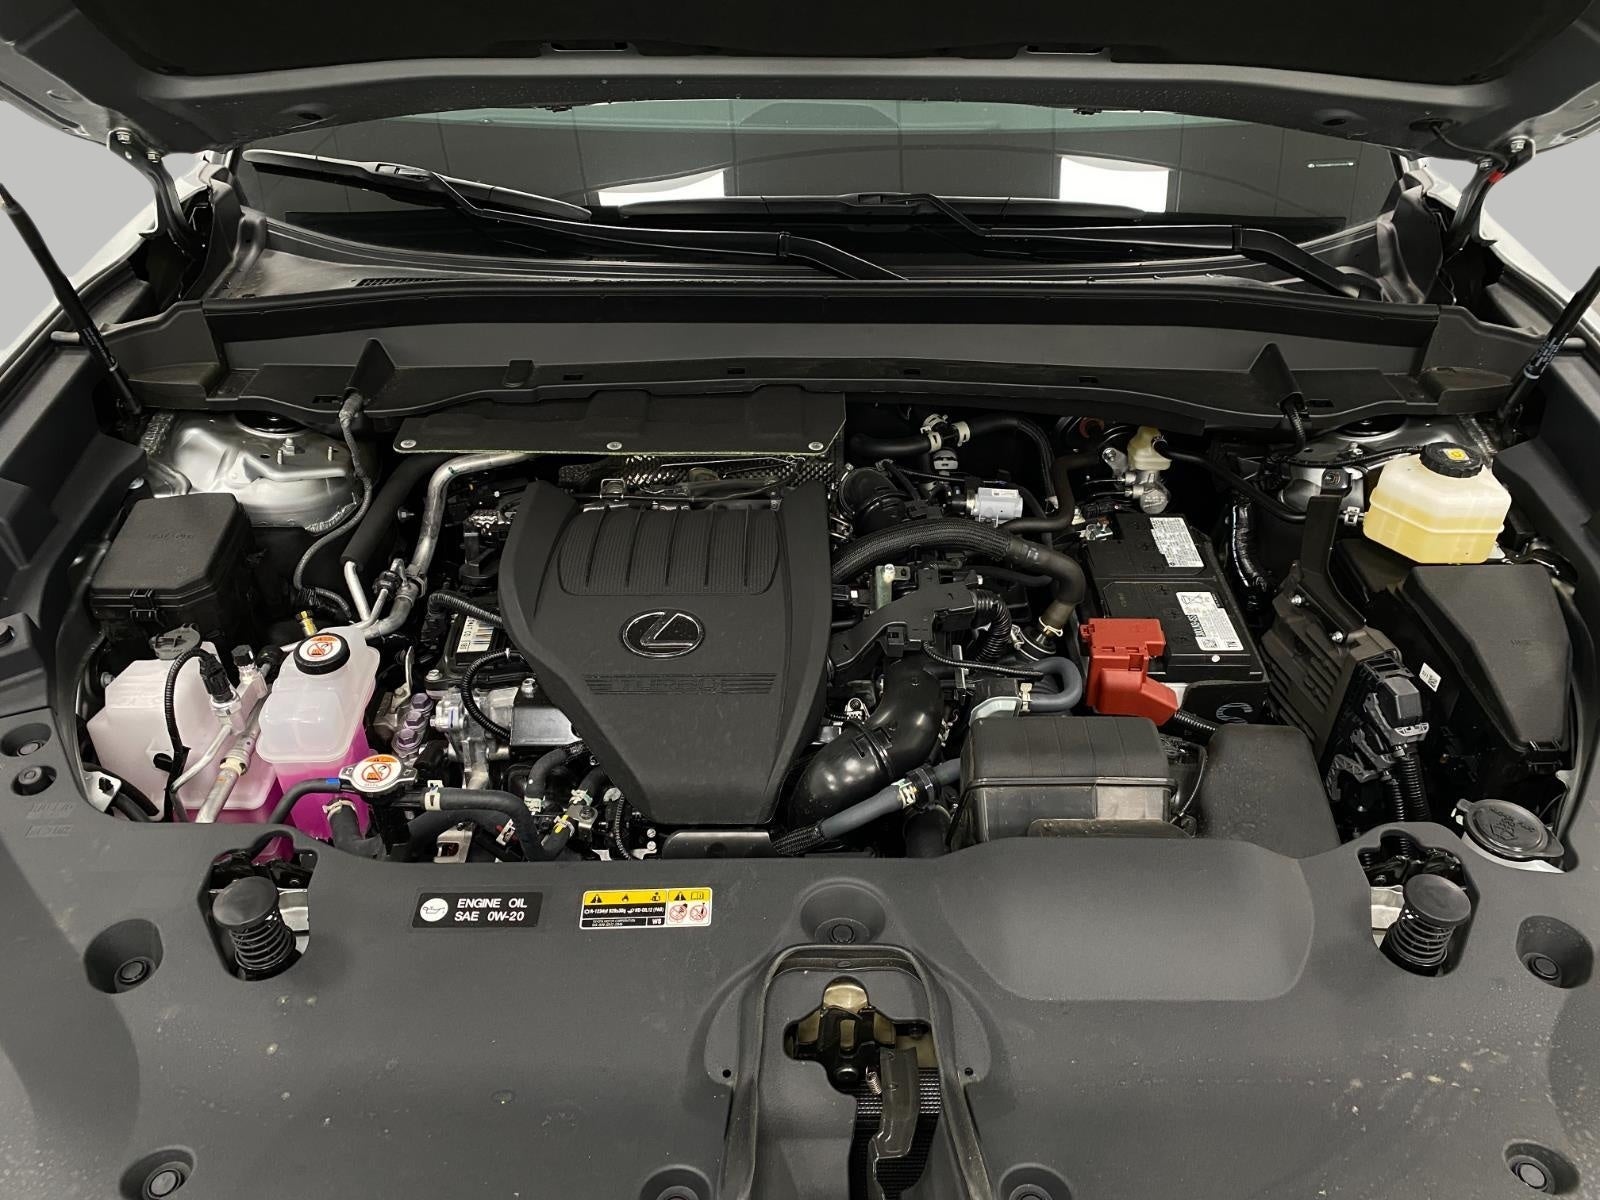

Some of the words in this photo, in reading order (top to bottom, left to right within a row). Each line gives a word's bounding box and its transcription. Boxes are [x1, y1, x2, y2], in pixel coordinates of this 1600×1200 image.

[457, 898, 502, 908] ENGINE
[508, 898, 527, 908] OIL
[454, 911, 480, 921] SAE
[487, 911, 525, 921] 0W-20
